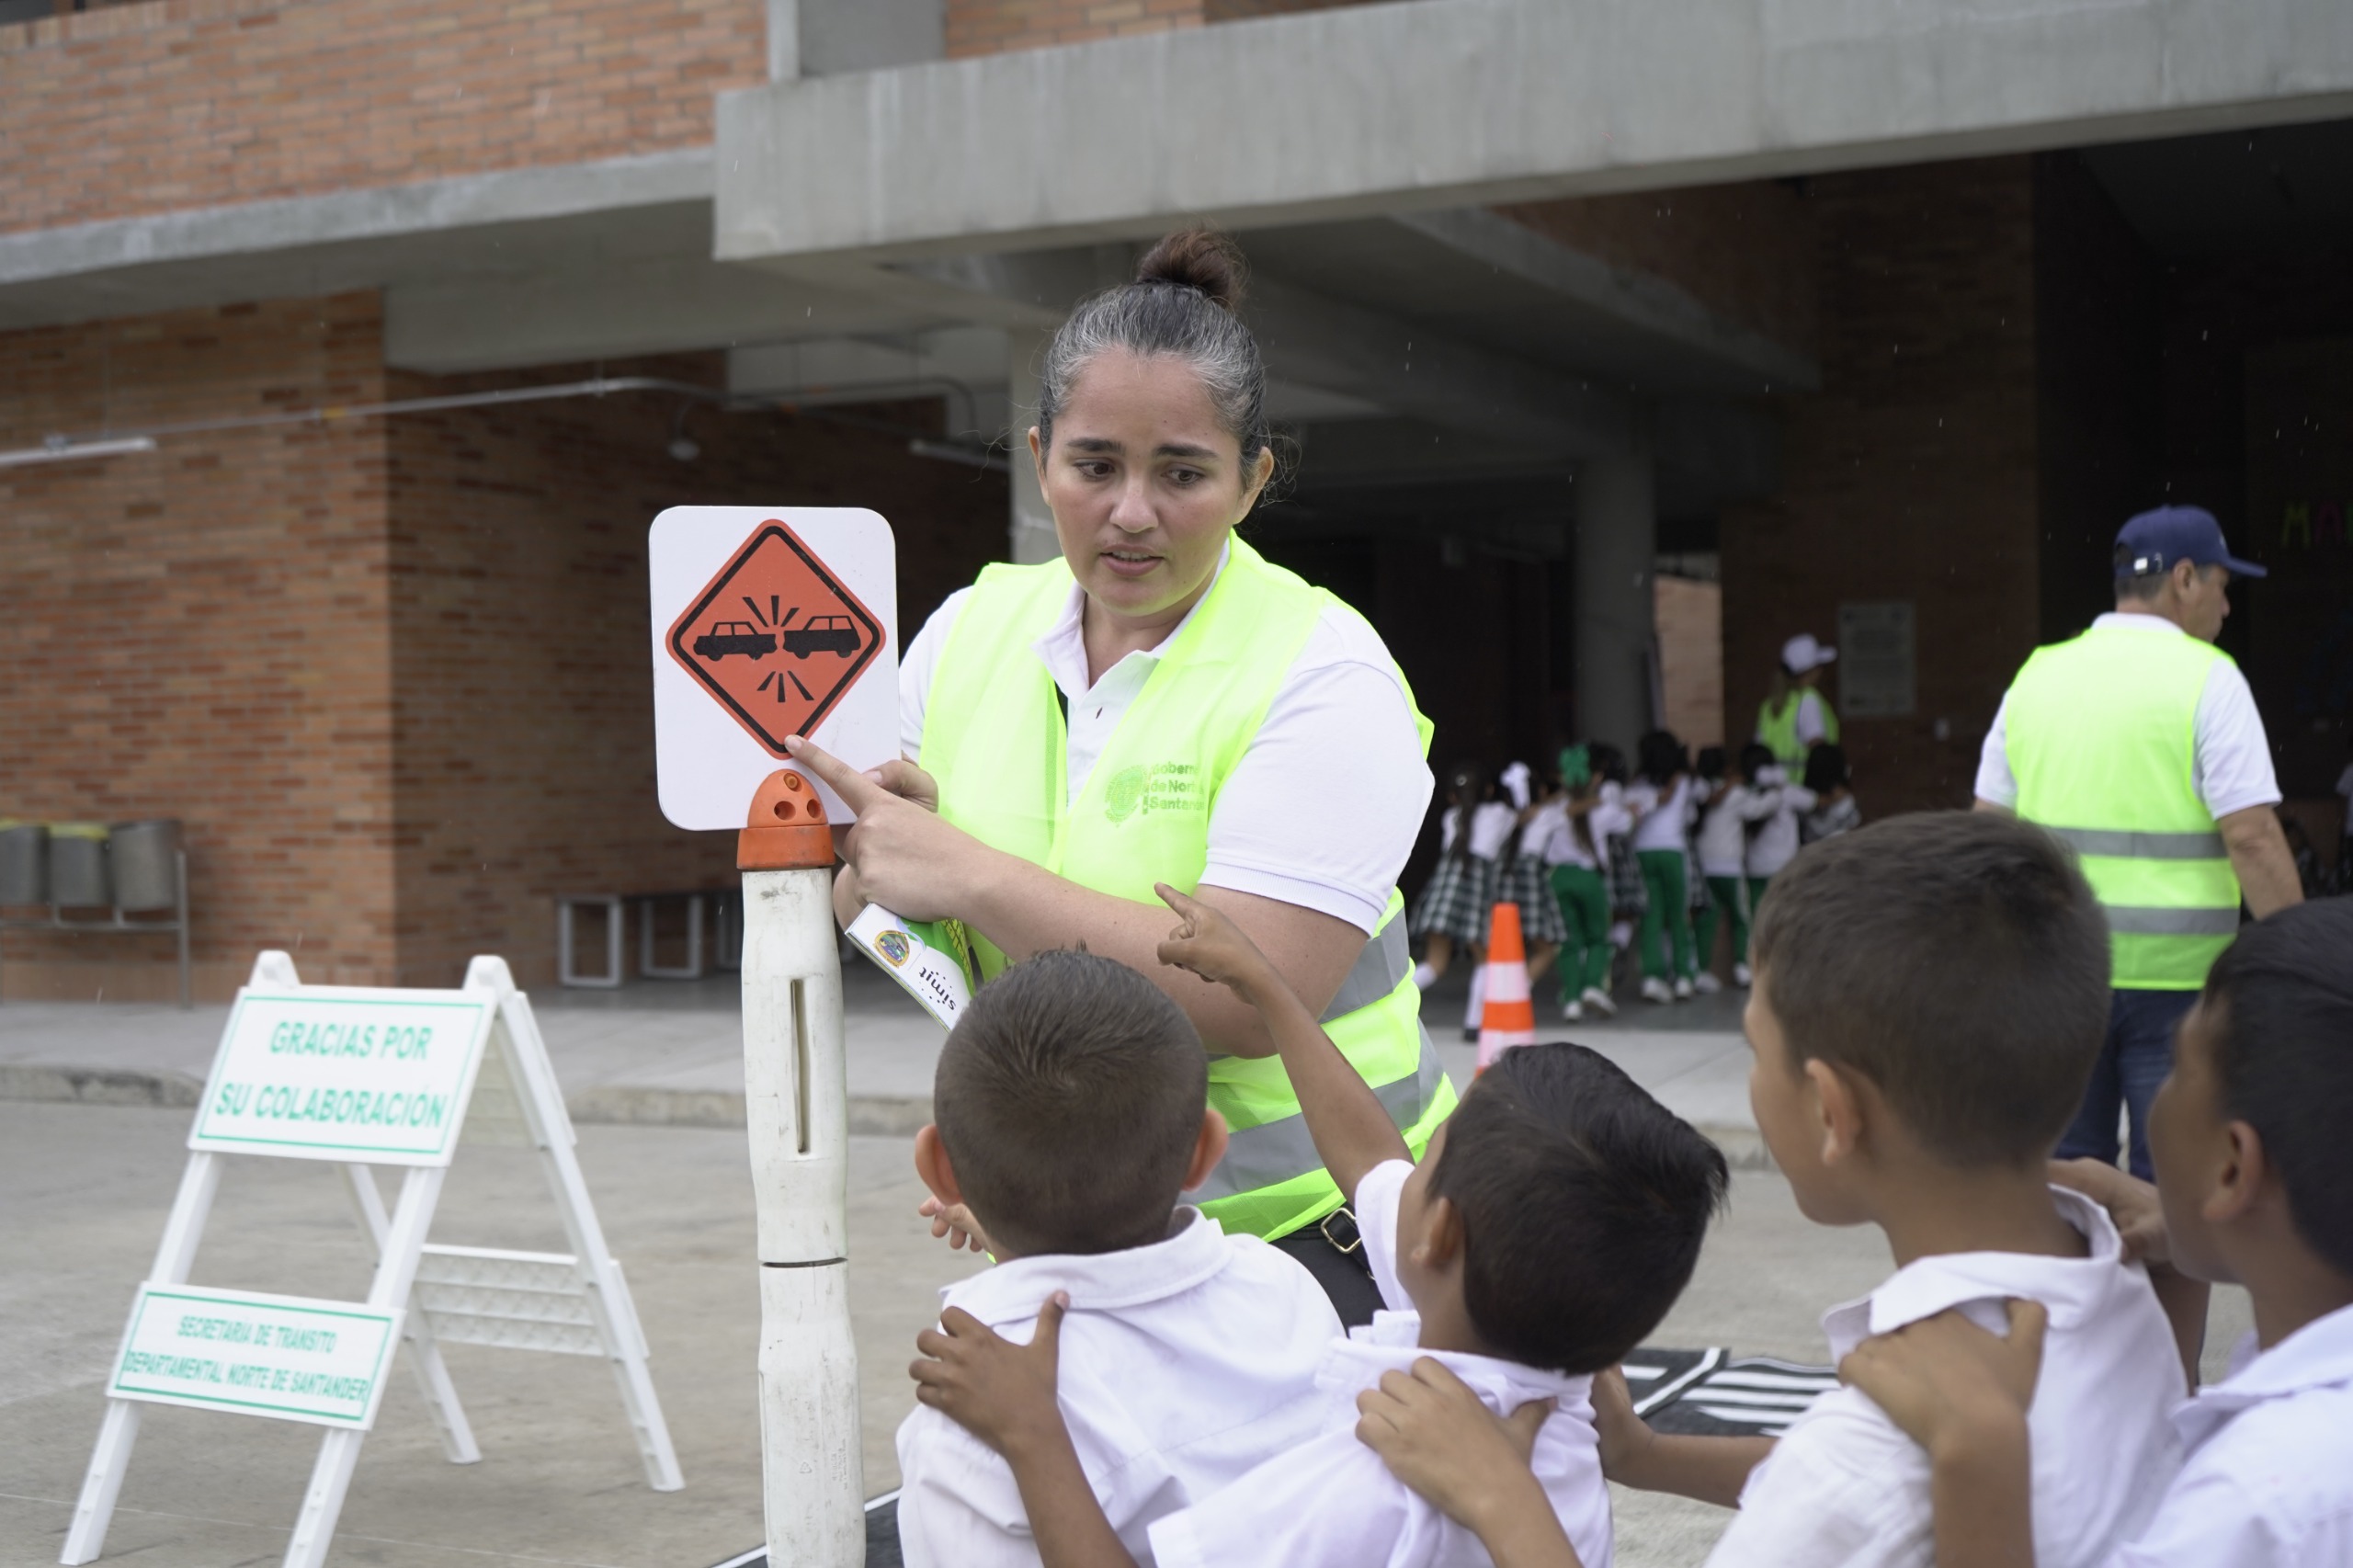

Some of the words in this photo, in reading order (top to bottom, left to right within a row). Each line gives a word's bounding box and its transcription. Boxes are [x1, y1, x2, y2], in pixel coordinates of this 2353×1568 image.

[919, 967, 957, 1011] simit
[270, 1021, 376, 1058] GRACIAS
[380, 1025, 433, 1060] POR
[215, 1082, 253, 1116] SU
[254, 1324, 274, 1346] DE
[121, 1350, 222, 1383] DEPARTAMENTAL
[226, 1363, 271, 1389] NORTE
[270, 1366, 291, 1392] DE
[290, 1370, 369, 1402] SANTANDER
